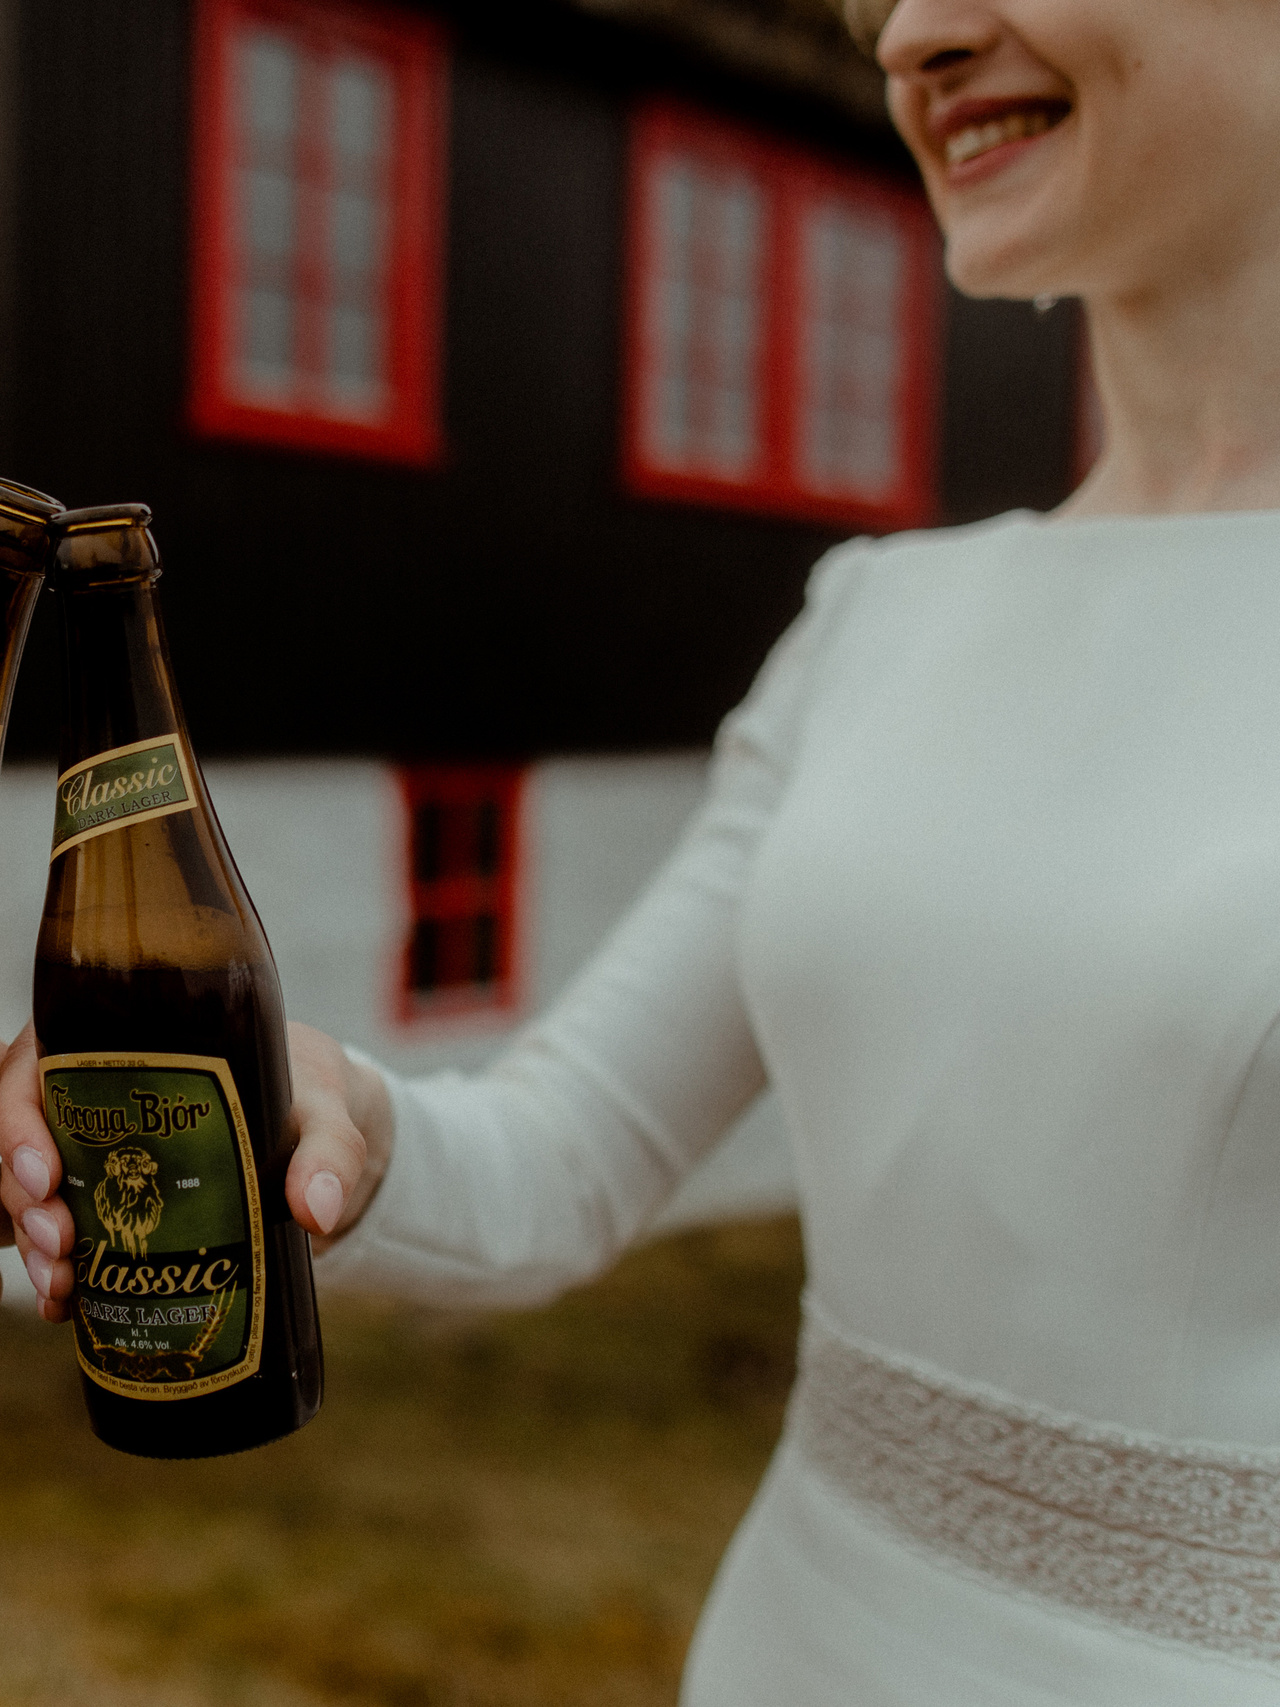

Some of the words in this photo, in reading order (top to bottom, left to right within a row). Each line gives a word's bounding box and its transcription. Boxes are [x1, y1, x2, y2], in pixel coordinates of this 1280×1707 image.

[62, 757, 178, 817] Classic
[77, 806, 118, 830] DARK
[122, 791, 173, 814] LAGER
[76, 1059, 98, 1067] LAGER
[103, 1059, 126, 1067] NETTO
[129, 1088, 211, 1140] Bjór
[175, 1178, 201, 1190] 1888
[251, 1207, 260, 1218] og
[254, 1296, 262, 1307] og
[80, 1296, 132, 1324] DARK
[136, 1303, 219, 1326] LAGER
[131, 1328, 142, 1338] kl.
[130, 1339, 153, 1350] 4.6%
[163, 1381, 198, 1395] Bryggjað
[199, 1379, 209, 1388] av
